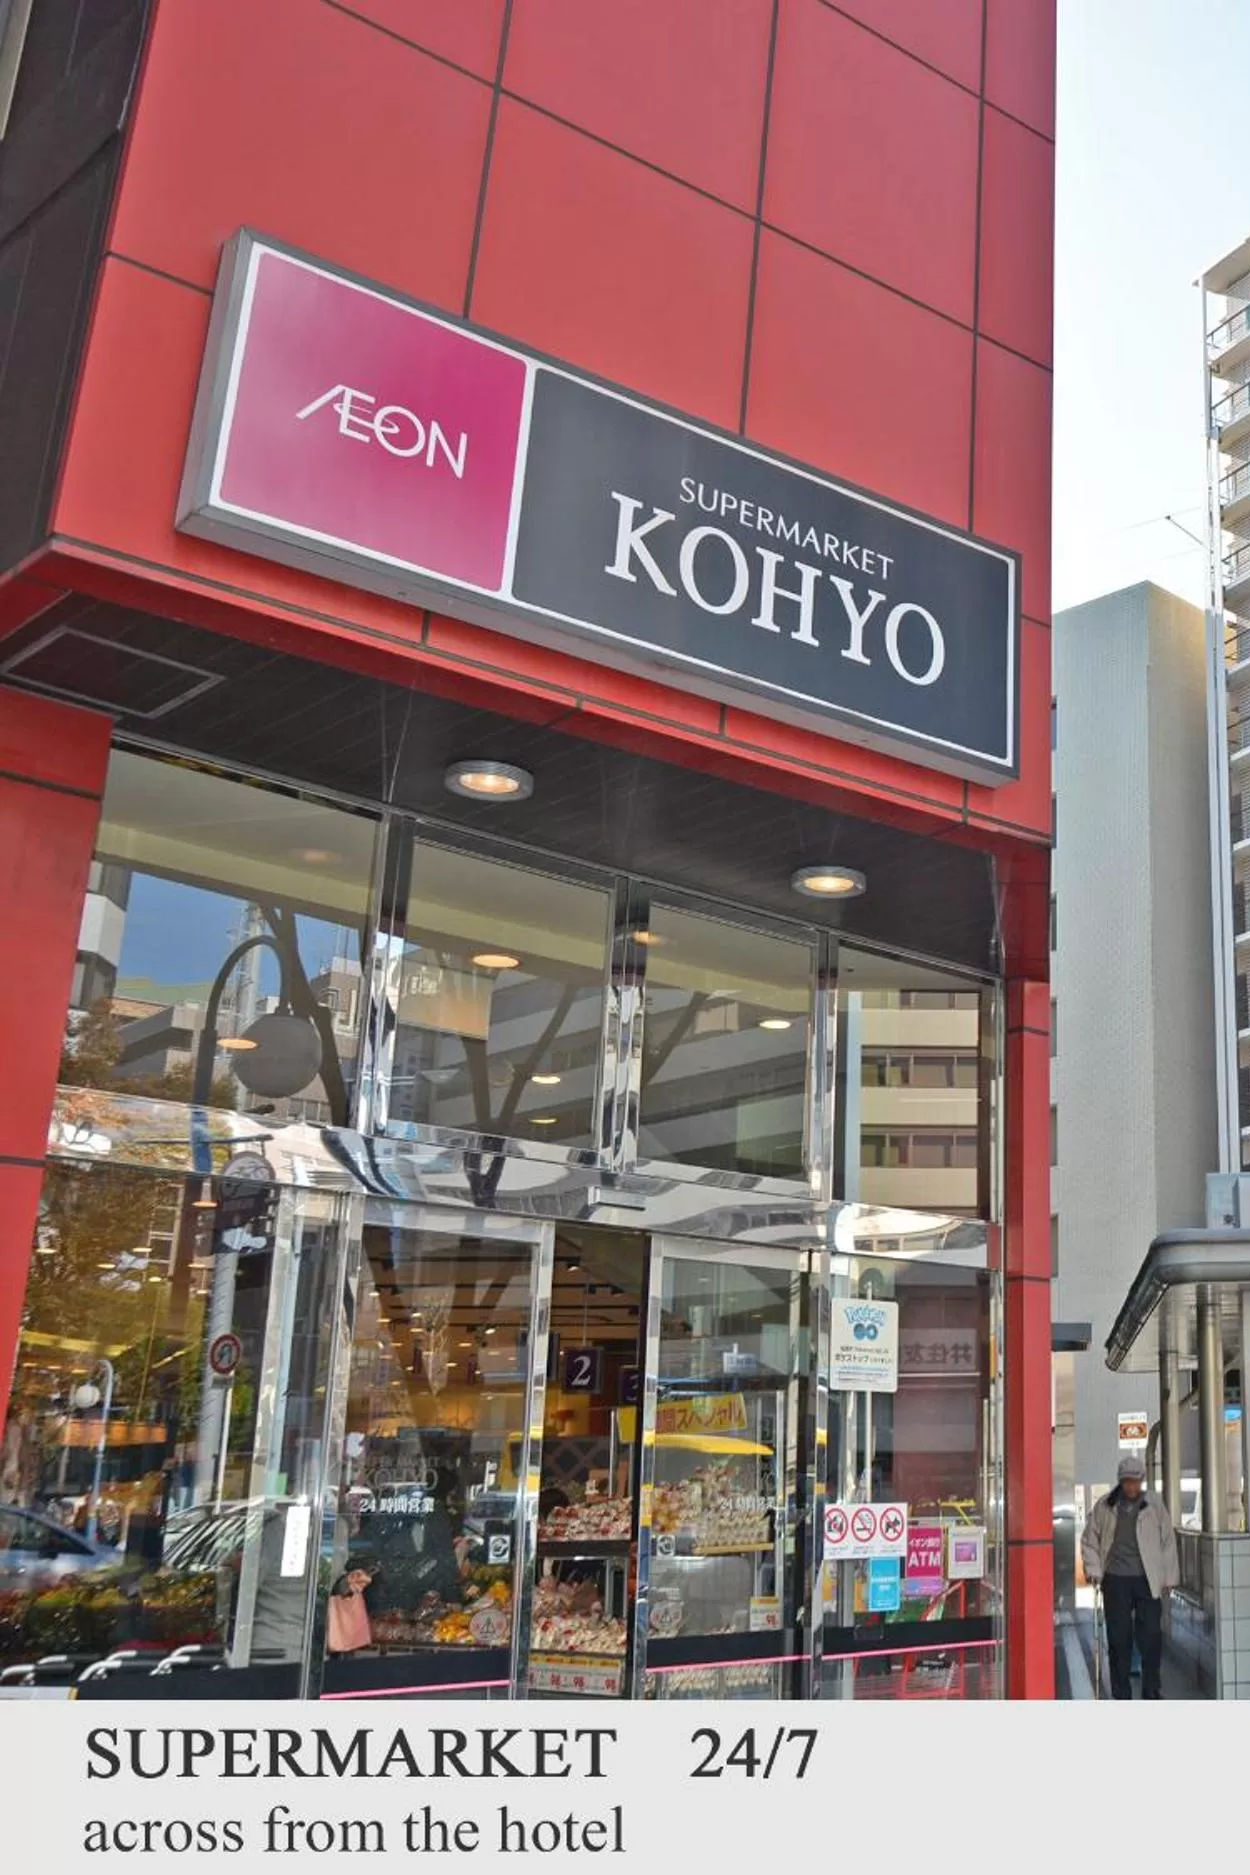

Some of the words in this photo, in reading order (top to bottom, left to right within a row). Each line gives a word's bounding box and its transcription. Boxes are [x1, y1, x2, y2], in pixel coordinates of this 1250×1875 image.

[679, 476, 894, 581] SUPERMARKET
[604, 491, 946, 688] KOHYO
[571, 1356, 591, 1386] 2
[359, 1499, 376, 1513] 24
[908, 1550, 941, 1568] ATM
